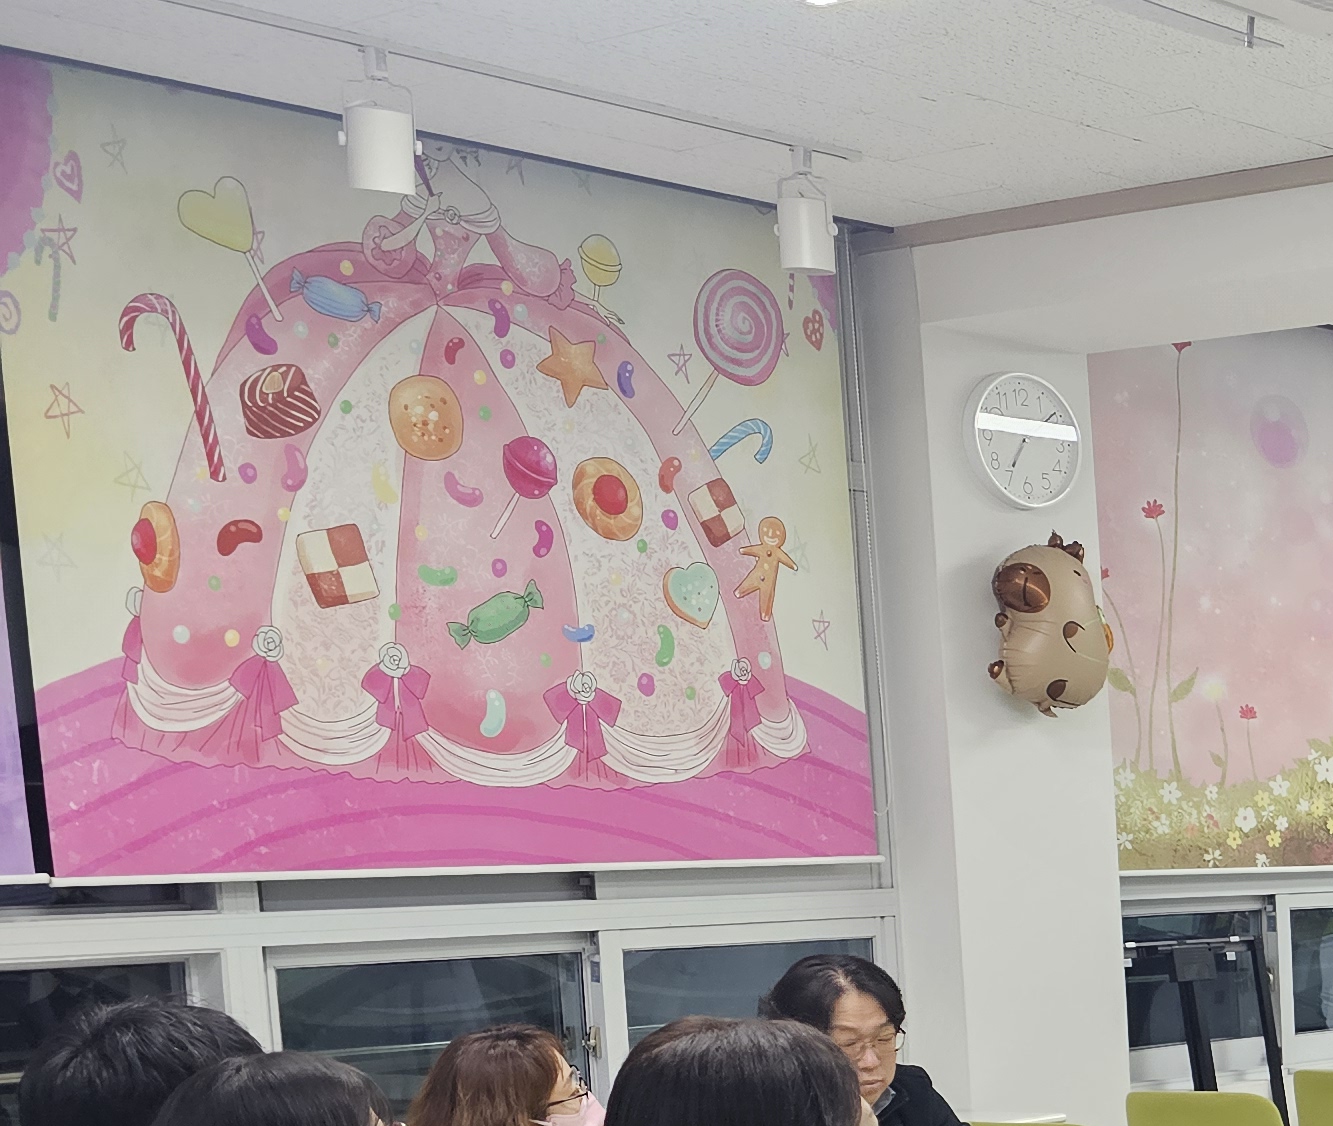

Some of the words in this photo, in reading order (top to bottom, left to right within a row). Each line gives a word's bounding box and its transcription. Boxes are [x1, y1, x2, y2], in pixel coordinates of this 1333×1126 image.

[996, 391, 1008, 410] 11
[1012, 388, 1029, 407] 12
[991, 452, 1000, 470] 8
[1052, 460, 1062, 474] 4
[1005, 469, 1014, 486] 7
[1023, 476, 1033, 494] 6
[1041, 473, 1051, 490] 5
